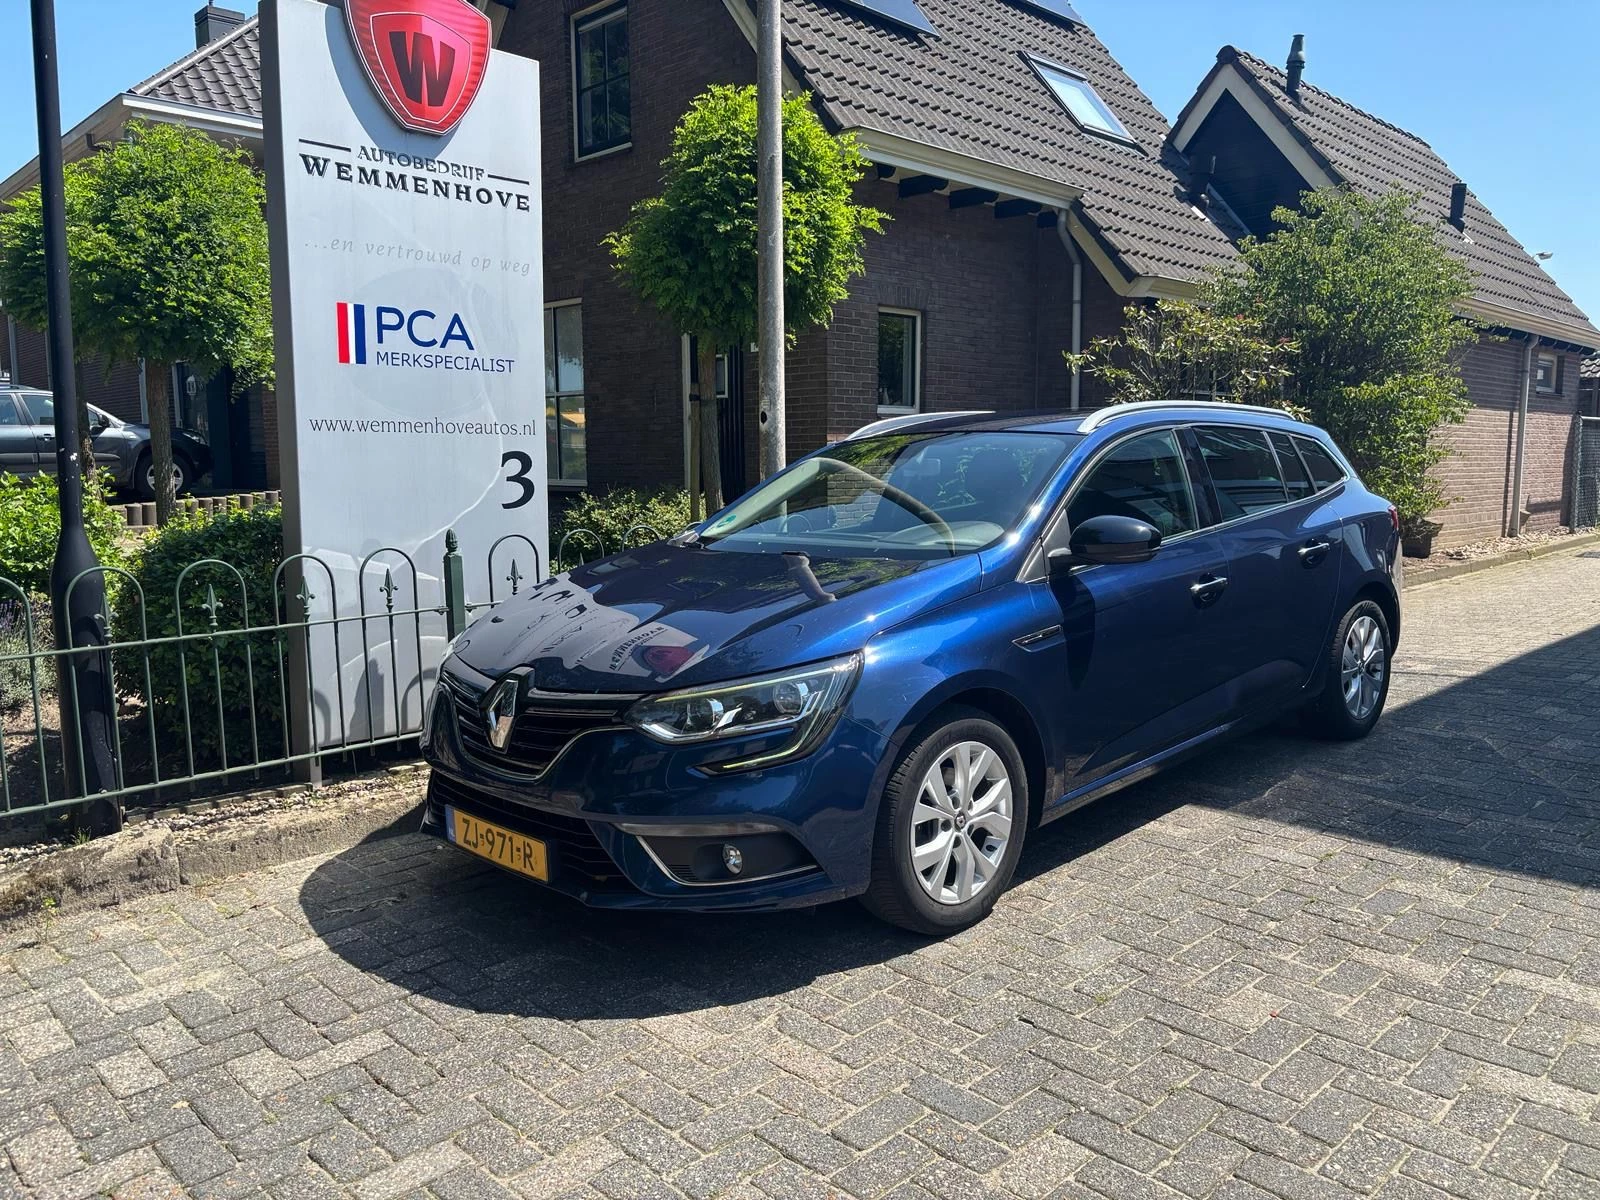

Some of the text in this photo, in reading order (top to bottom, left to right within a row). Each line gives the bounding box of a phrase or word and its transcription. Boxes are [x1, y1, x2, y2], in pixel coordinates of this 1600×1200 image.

[388, 31, 456, 107] W
[299, 153, 530, 212] WEMMENHOVE
[357, 145, 485, 182] AUTOBEDRIJF
[365, 242, 462, 266] vertrouwd
[471, 255, 491, 272] op
[500, 258, 531, 277] weg
[376, 306, 475, 350] PCA
[376, 351, 515, 373] MERKSPECIALIST
[309, 417, 536, 436] www.wemmenhoveautos.nl
[501, 450, 535, 510] 3
[462, 817, 535, 871] ZJ-971-R
